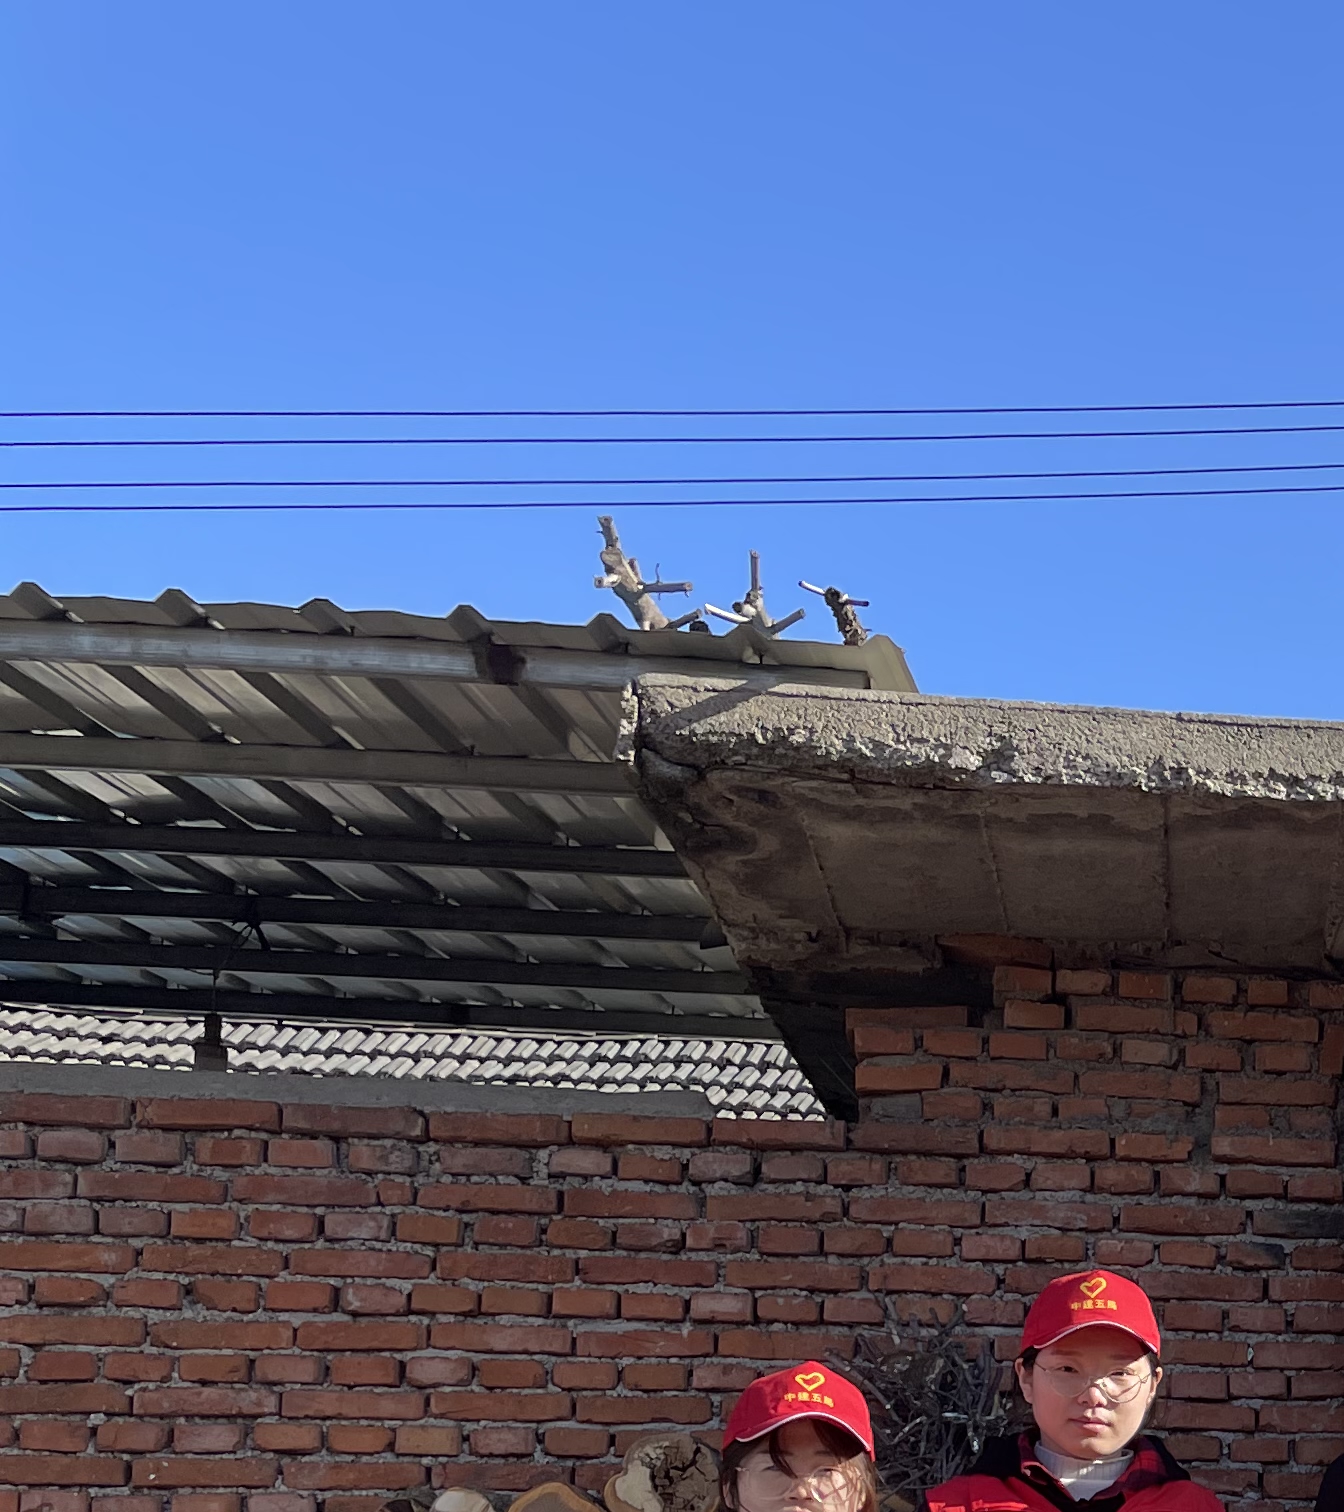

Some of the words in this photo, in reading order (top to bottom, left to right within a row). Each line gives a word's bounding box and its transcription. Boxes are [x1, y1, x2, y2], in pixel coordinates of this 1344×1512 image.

[1071, 1299, 1118, 1311] 中建五局
[784, 1391, 834, 1408] 中建五局
